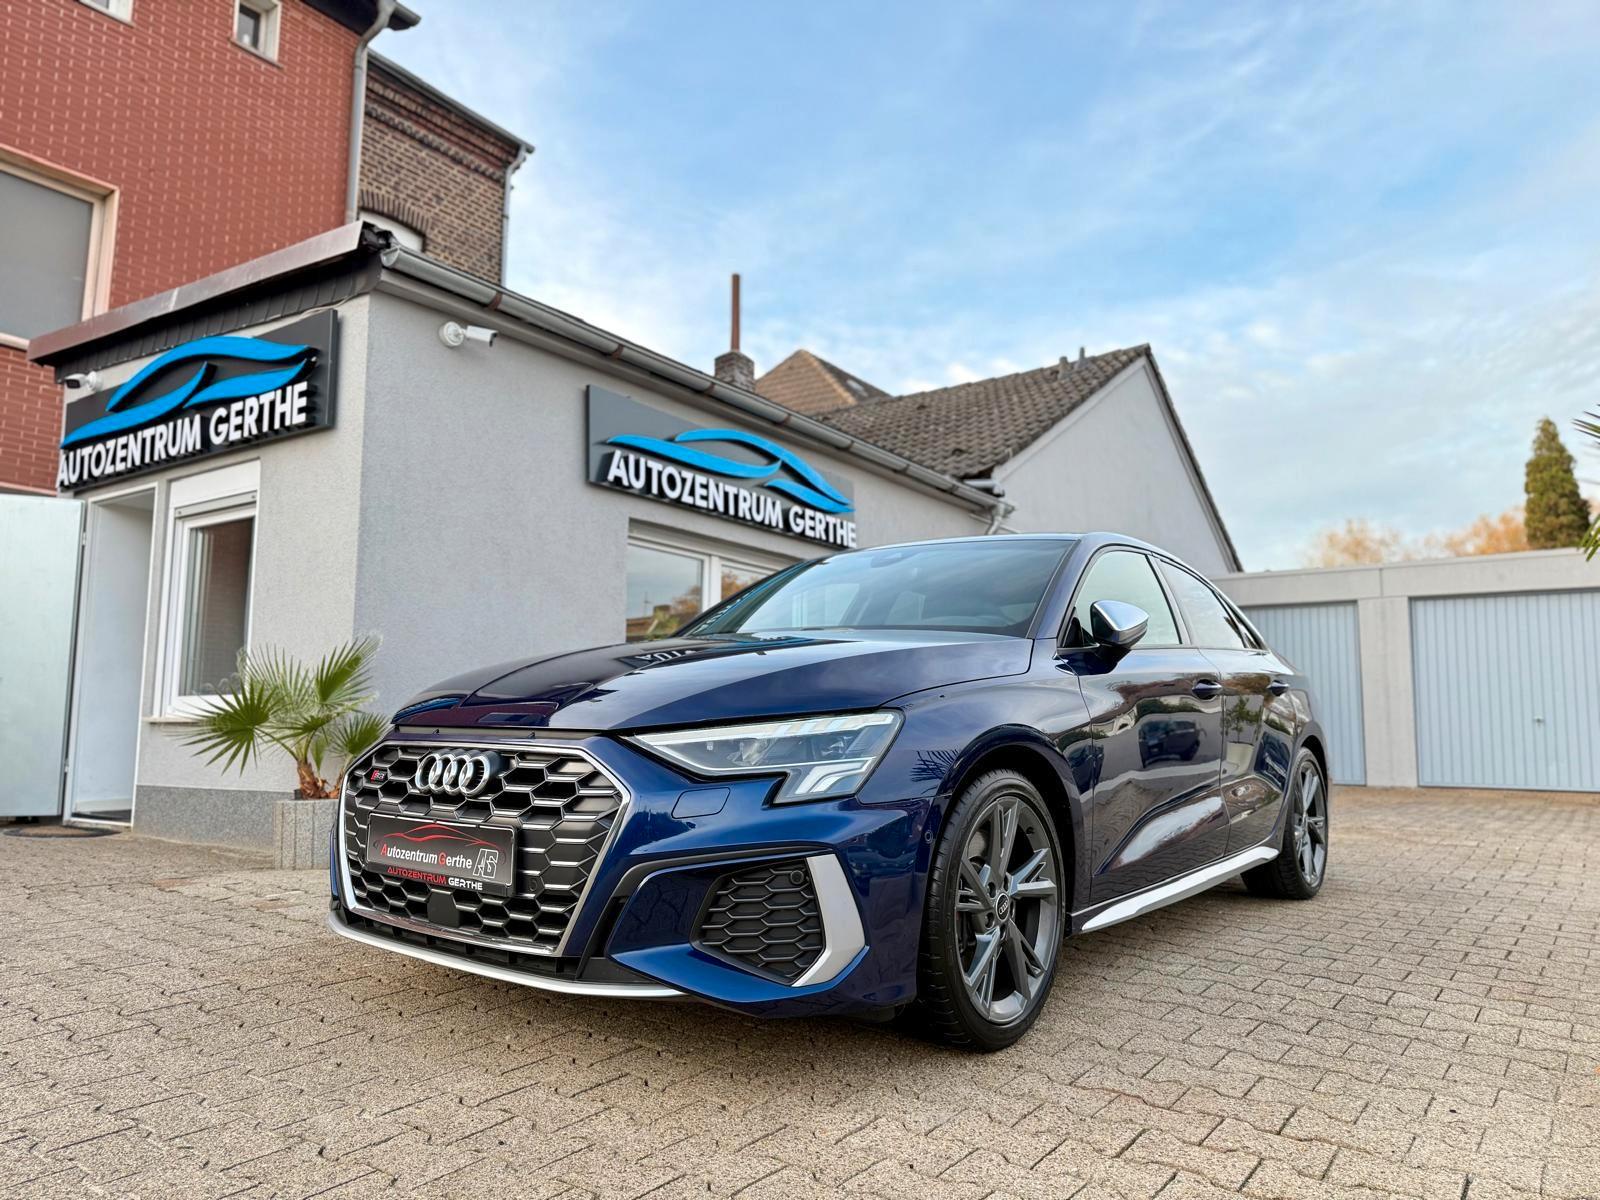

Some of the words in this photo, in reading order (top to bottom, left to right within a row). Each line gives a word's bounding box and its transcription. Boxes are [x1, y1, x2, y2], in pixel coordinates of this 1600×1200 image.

[55, 414, 200, 488] AUTOZENTRUM
[209, 381, 308, 445] GERTHE
[607, 449, 784, 529] AUTOZENTRUM
[788, 505, 857, 548] GERTHE
[380, 843, 438, 865] Autozentrum
[438, 852, 472, 869] Gerthe
[387, 866, 447, 885] AUTOZENTRUM
[448, 877, 483, 890] GERTHE
